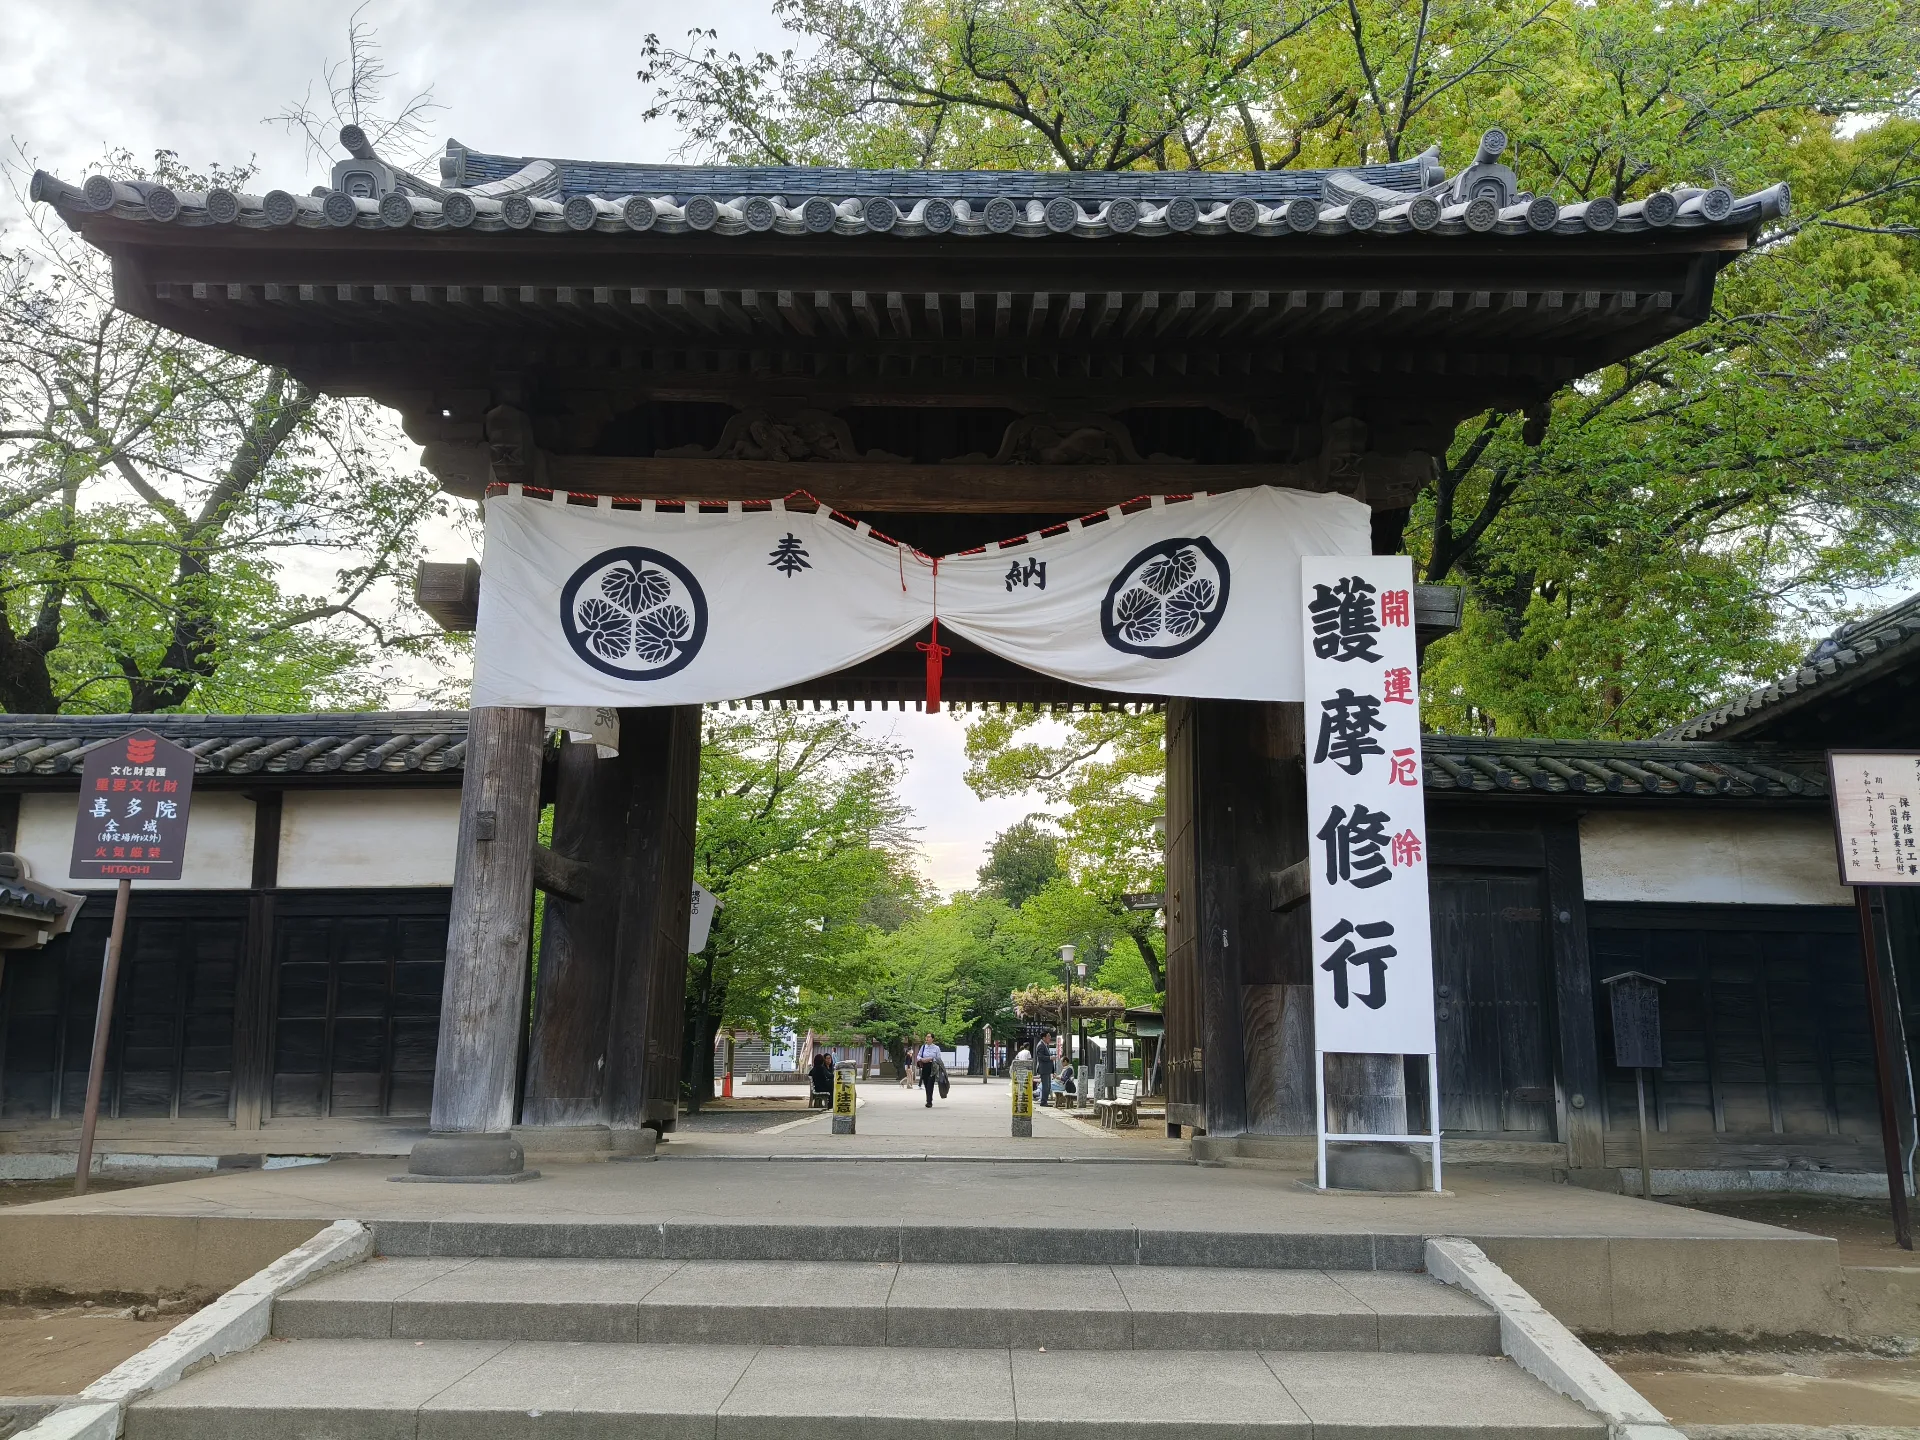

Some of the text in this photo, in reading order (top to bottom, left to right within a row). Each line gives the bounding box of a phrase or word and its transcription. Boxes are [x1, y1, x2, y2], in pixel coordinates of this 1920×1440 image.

[768, 532, 1047, 592] 奉 納
[1381, 589, 1422, 868] 開運厄除
[111, 766, 166, 777] 文化財愛護
[95, 778, 178, 792] 重要文化財
[1308, 576, 1398, 1009] 護摩修行
[89, 797, 177, 818] 喜多院
[105, 819, 157, 833] 全域
[1899, 797, 1919, 875] 保存修理工事
[95, 847, 161, 858] 火気厳禁
[101, 865, 150, 874] HITACHI
[1014, 1071, 1029, 1113] 下注意
